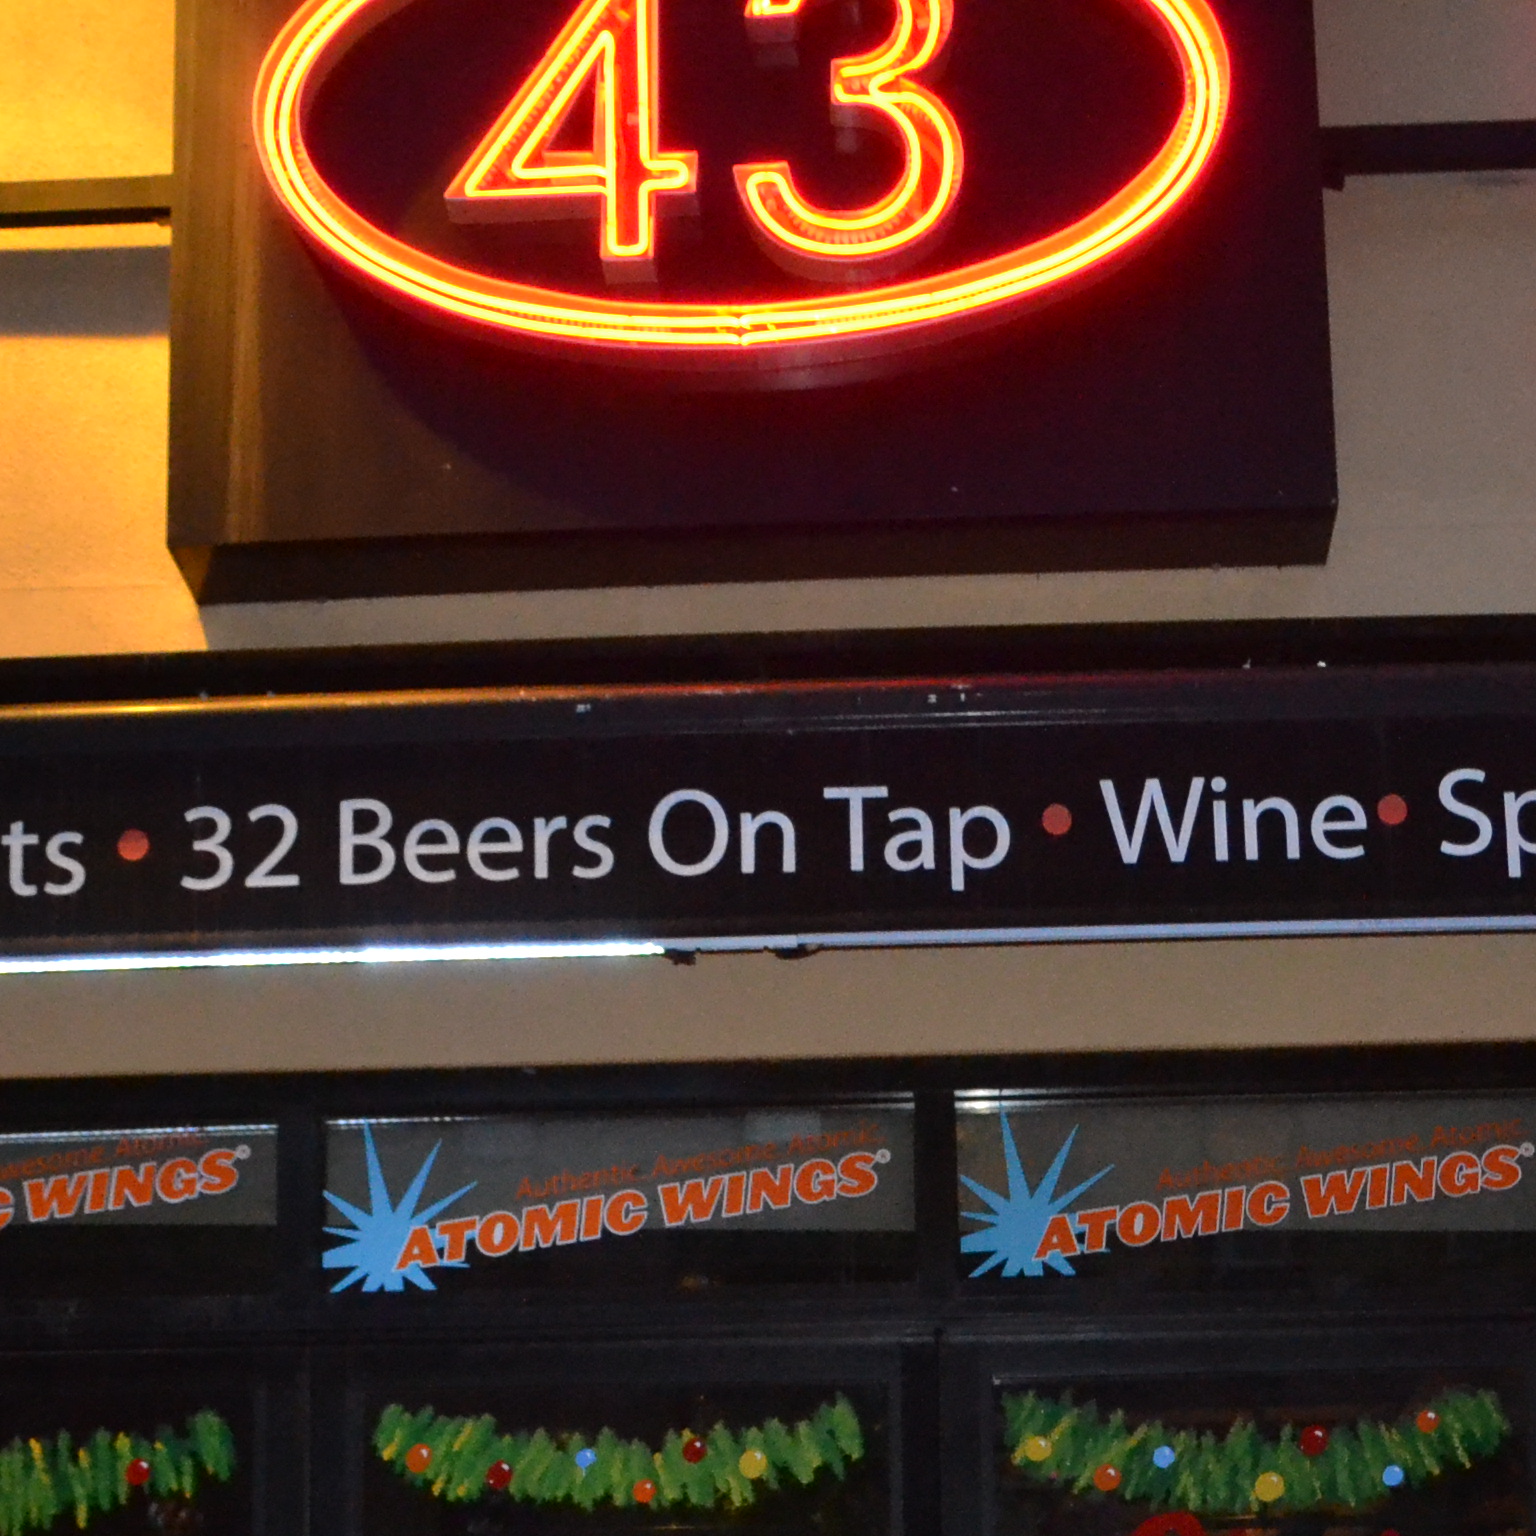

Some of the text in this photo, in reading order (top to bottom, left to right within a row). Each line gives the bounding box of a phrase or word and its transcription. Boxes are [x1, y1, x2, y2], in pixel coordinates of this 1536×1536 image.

[444, 0, 964, 262] 43
[180, 803, 301, 892] 32
[337, 796, 616, 886] Beers
[647, 788, 797, 878] On
[822, 784, 1012, 892] Tap
[1099, 775, 1368, 866] Wine
[391, 1188, 648, 1272] ATOMIC
[1031, 1180, 1290, 1261] ATOMIC
